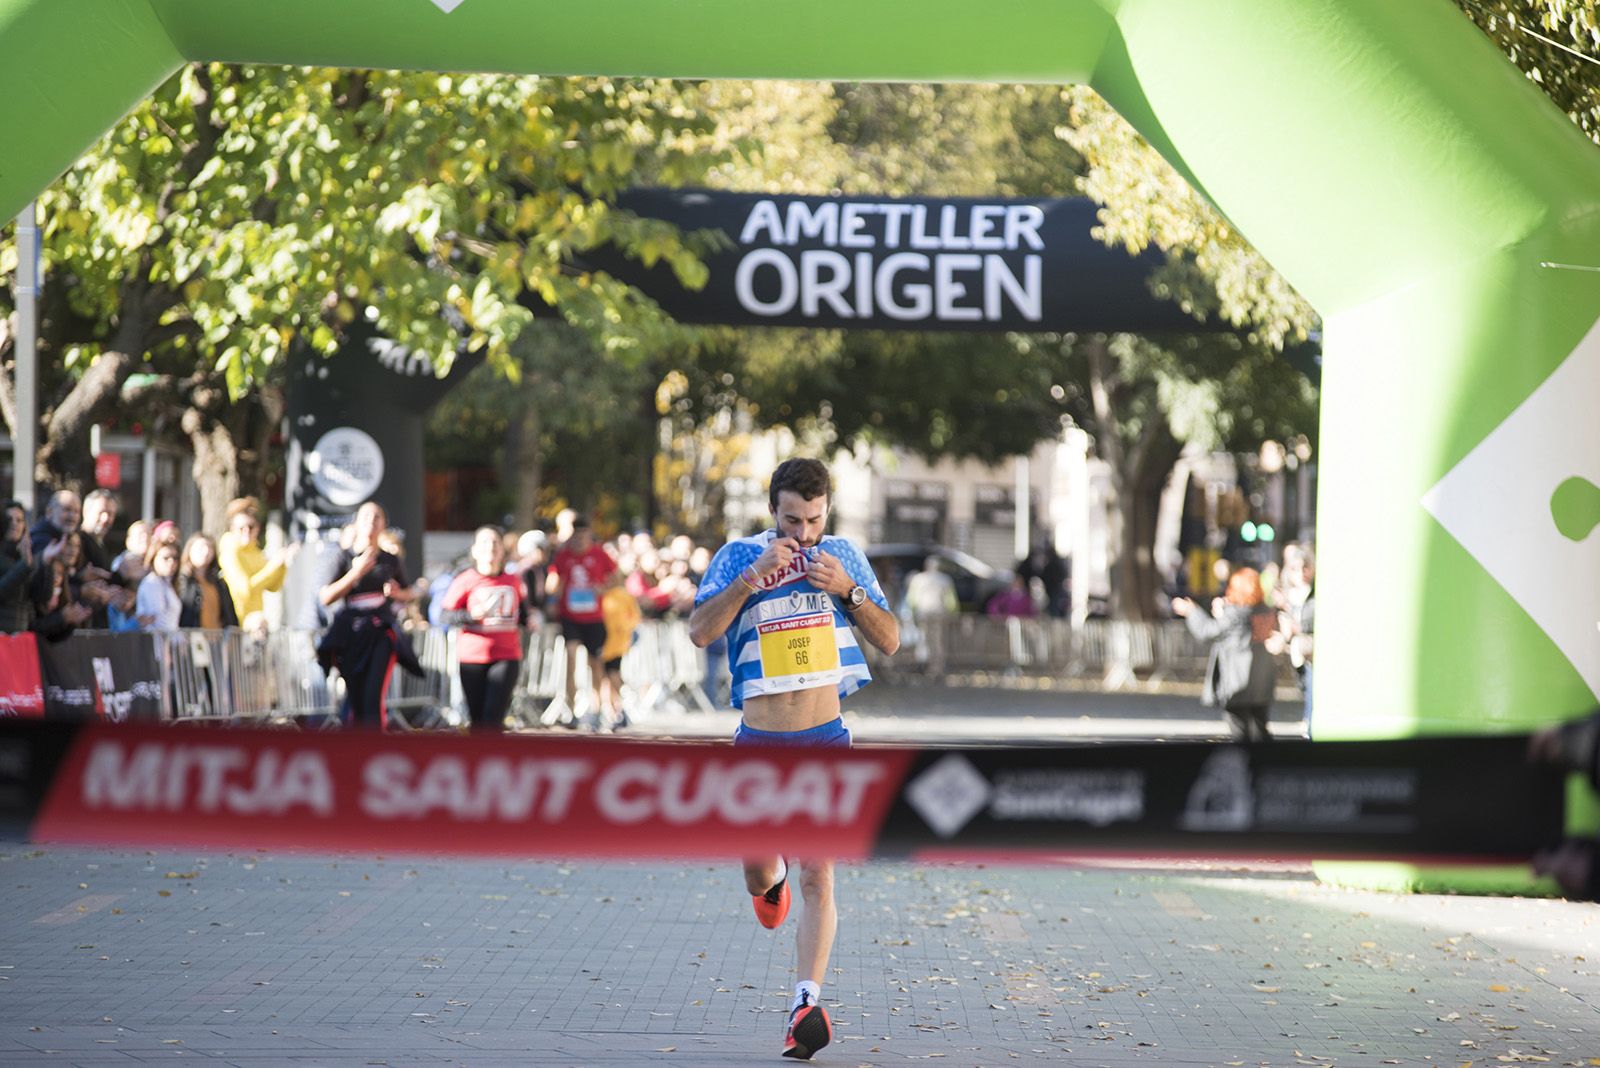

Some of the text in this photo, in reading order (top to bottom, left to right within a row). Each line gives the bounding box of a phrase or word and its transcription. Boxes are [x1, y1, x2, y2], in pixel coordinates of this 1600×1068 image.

[739, 199, 1045, 249] AMETLLER
[735, 248, 1043, 321] ORIGEN
[761, 623, 780, 633] MITJA
[780, 620, 799, 630] SANT
[799, 617, 822, 627] CUGAT
[787, 636, 811, 650] JOSEP
[795, 650, 808, 666] 66
[82, 740, 334, 818] MITJA
[361, 752, 589, 824] SANT
[594, 756, 884, 828] CUGAT
